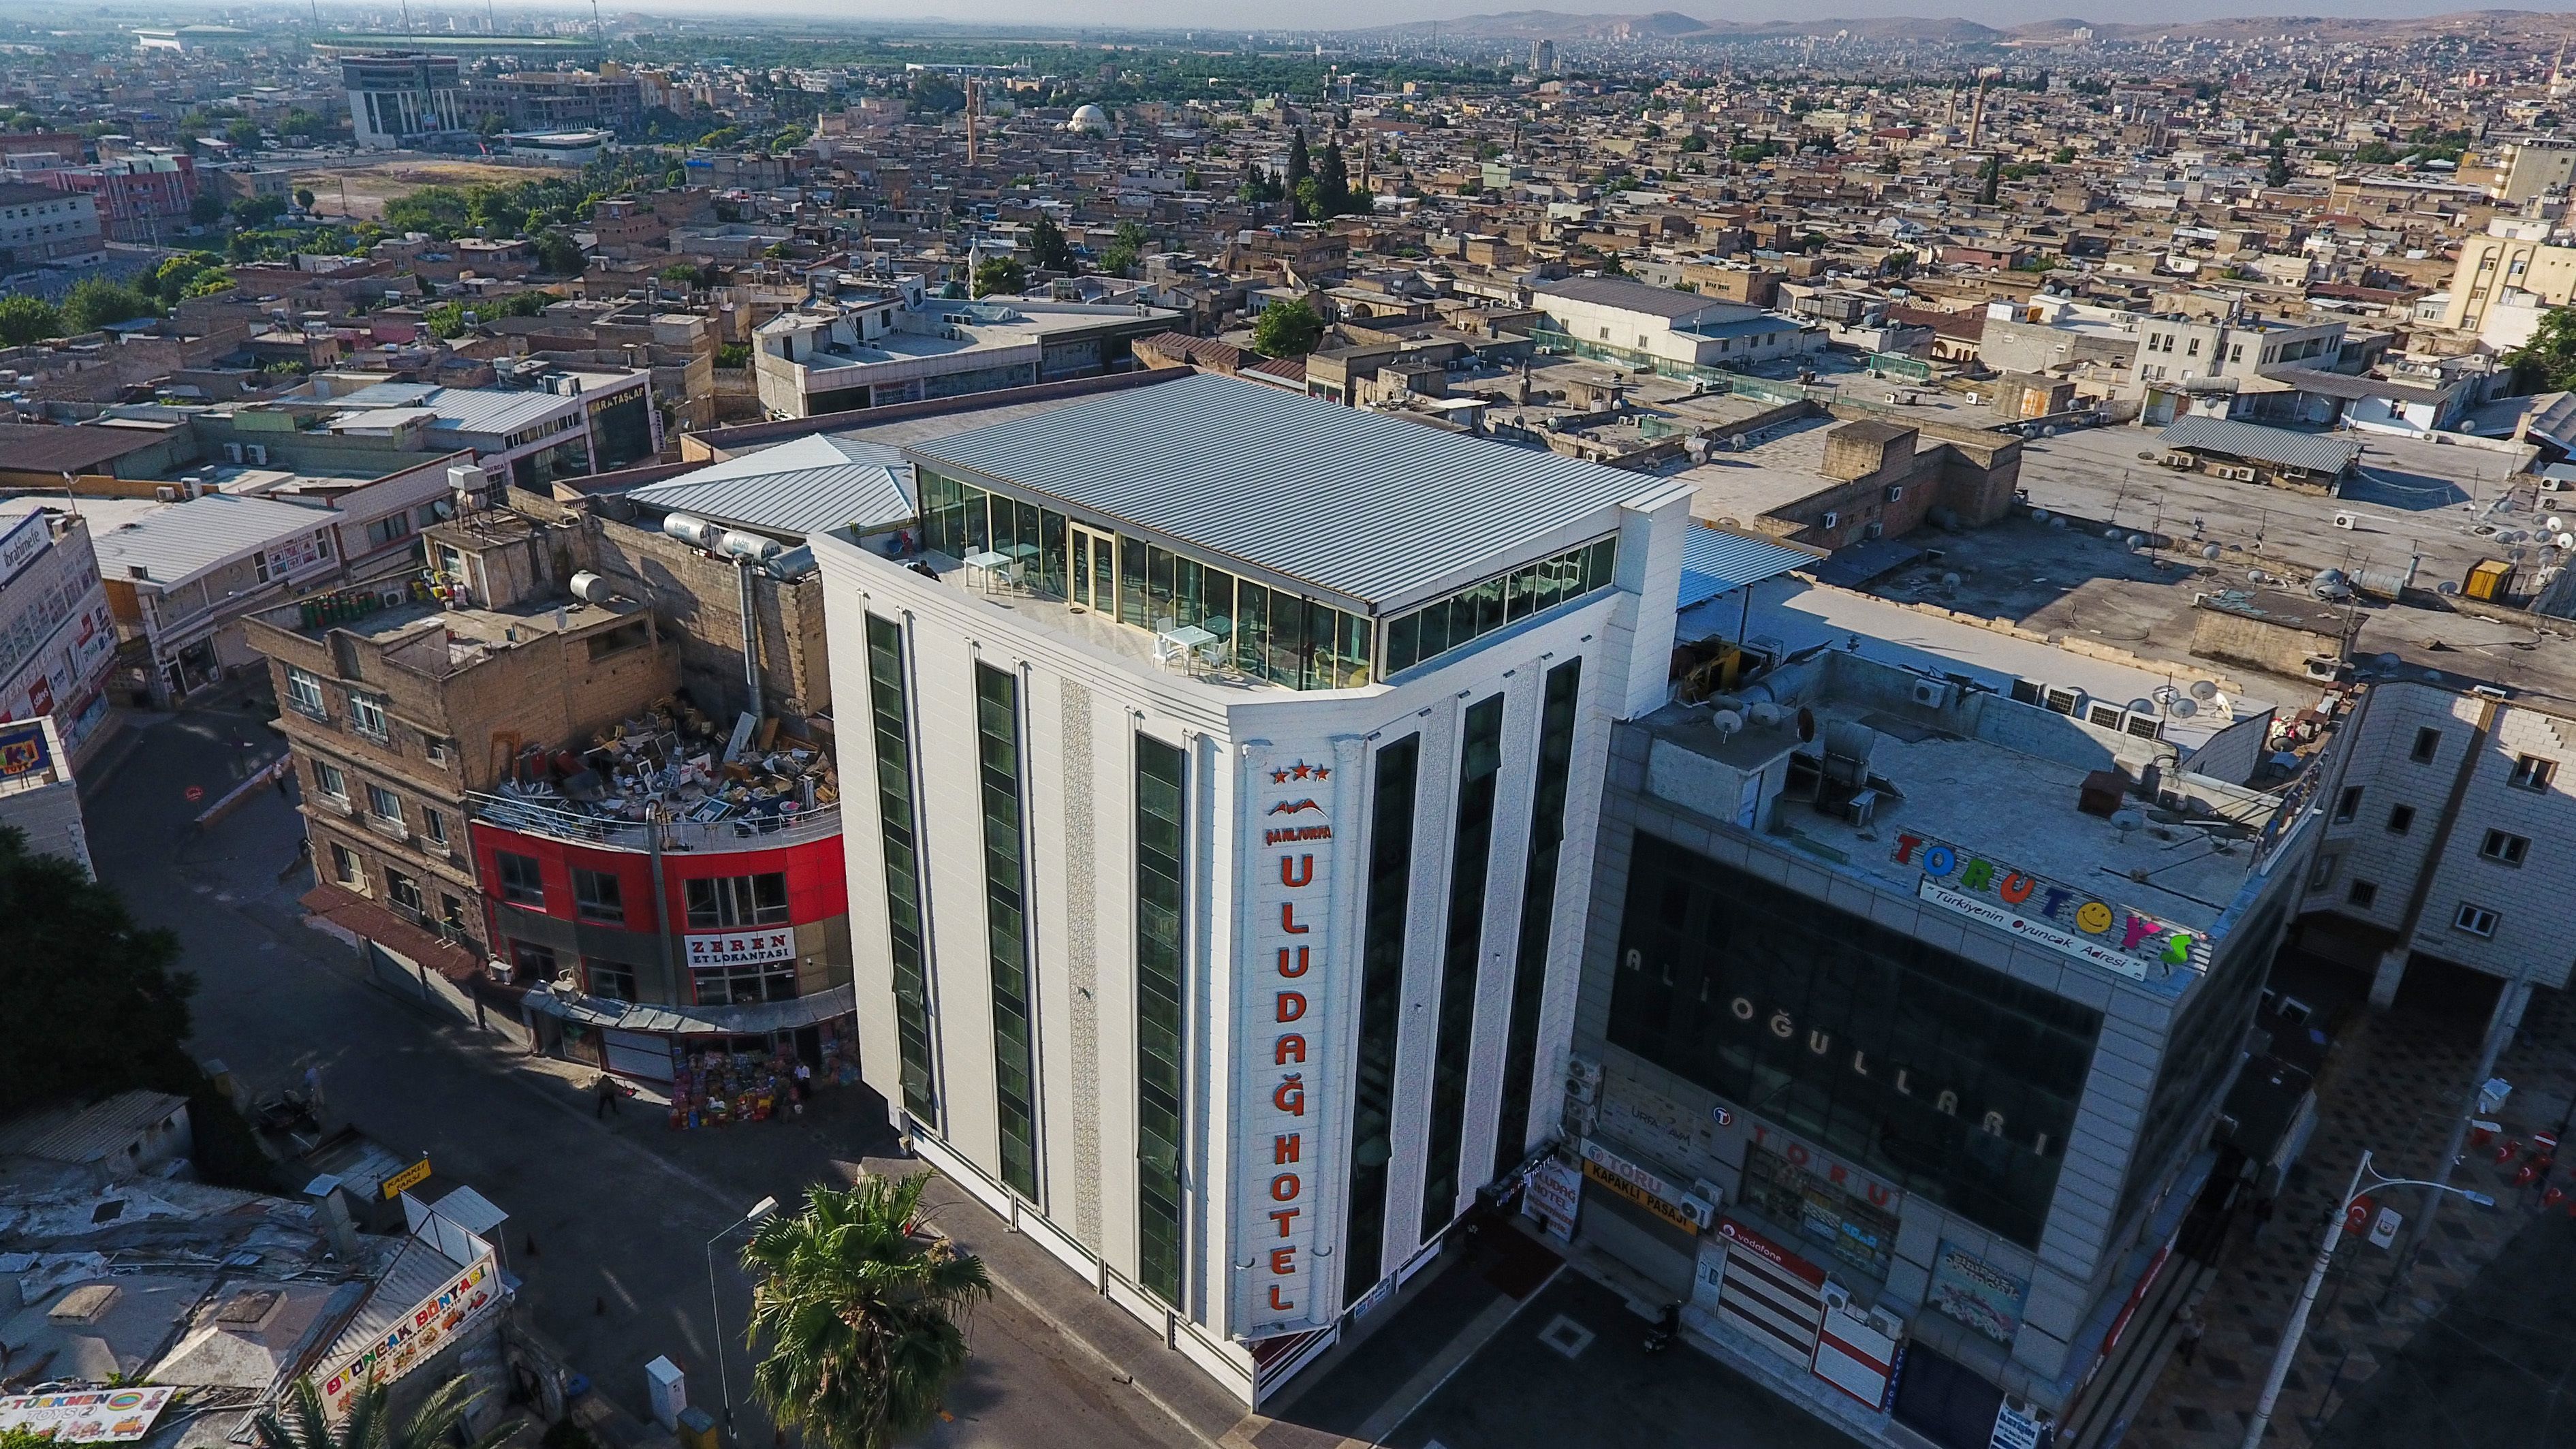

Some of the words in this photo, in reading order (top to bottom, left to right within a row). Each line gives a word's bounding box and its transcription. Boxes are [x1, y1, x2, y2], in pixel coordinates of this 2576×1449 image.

[1266, 825, 1332, 845] ŞANLIURFA
[691, 935, 786, 953] ZEREN
[2011, 919, 2073, 950] Oyuncak
[694, 955, 710, 963] ET
[713, 948, 789, 963] LOKANTASI
[1273, 853, 1314, 1117] ULUDAĞ
[1608, 1155, 1663, 1192] TORU
[1755, 1125, 1889, 1206] TORU
[1592, 1164, 1641, 1199] KAPAKLI
[1647, 1196, 1687, 1226] PASAJI
[1270, 1132, 1300, 1311] HOTEL
[1738, 1233, 1782, 1263] vodafone
[326, 1323, 413, 1396] OYUNCAK
[415, 1264, 487, 1329] DÜNYASI
[12, 1394, 111, 1409] TÜRKMEN
[26, 1407, 78, 1421] TOYS
